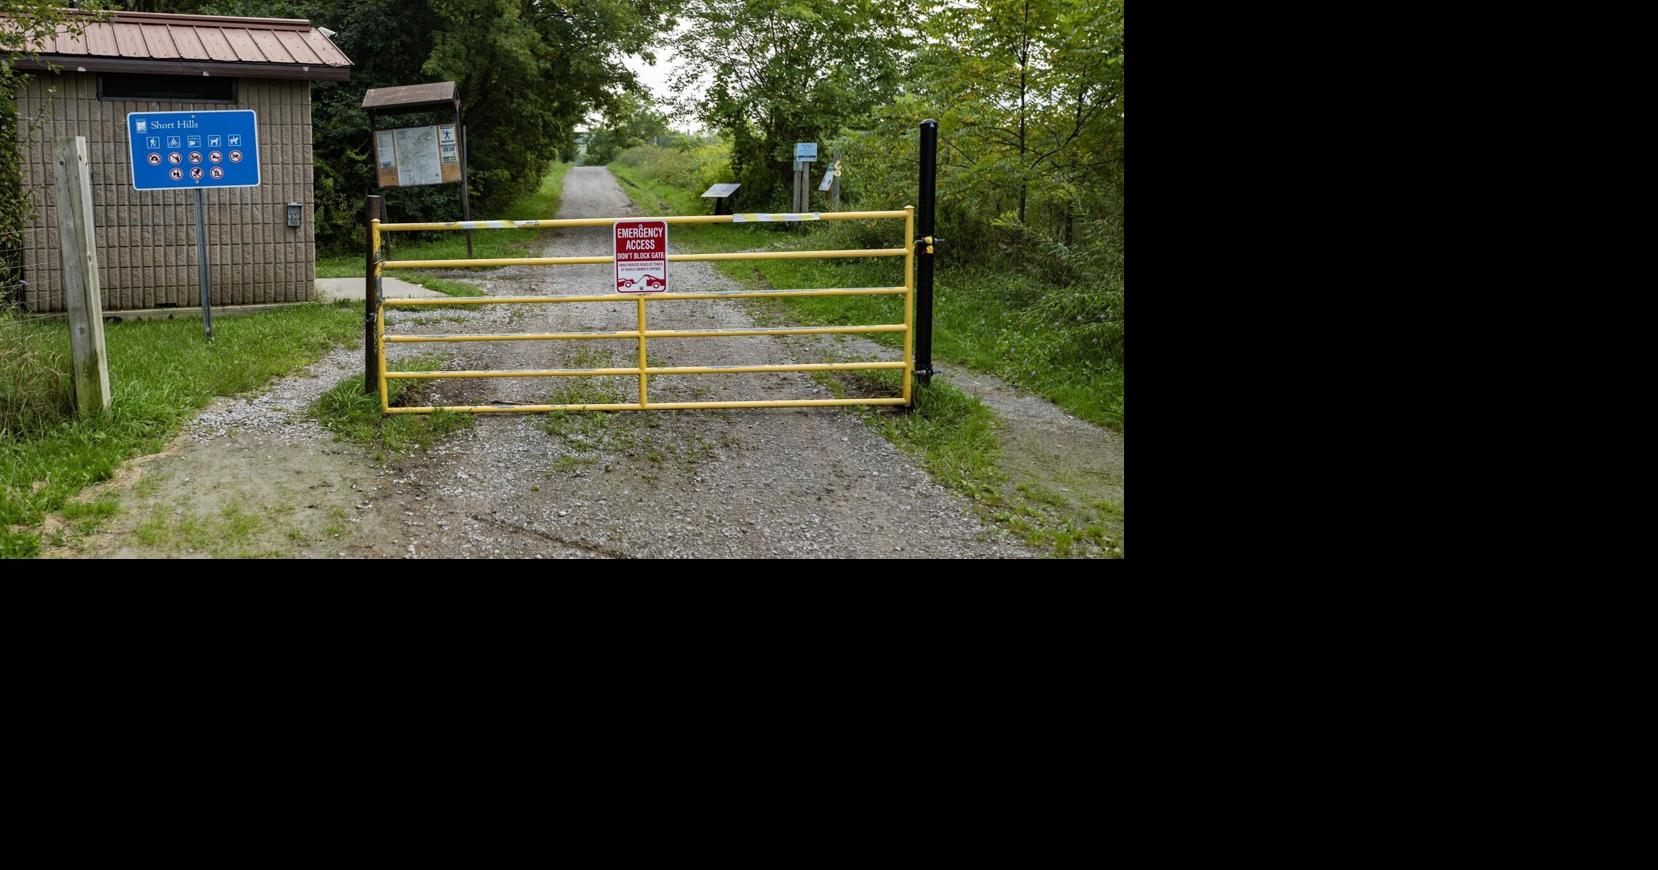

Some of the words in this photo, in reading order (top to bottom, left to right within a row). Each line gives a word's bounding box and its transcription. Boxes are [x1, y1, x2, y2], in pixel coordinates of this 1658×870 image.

[150, 120, 175, 129] Short
[177, 119, 199, 129] Hills
[617, 227, 664, 238] EMERGENCY
[625, 239, 656, 250] ACCESS
[617, 252, 633, 260] DON'T
[651, 251, 665, 259] GATE
